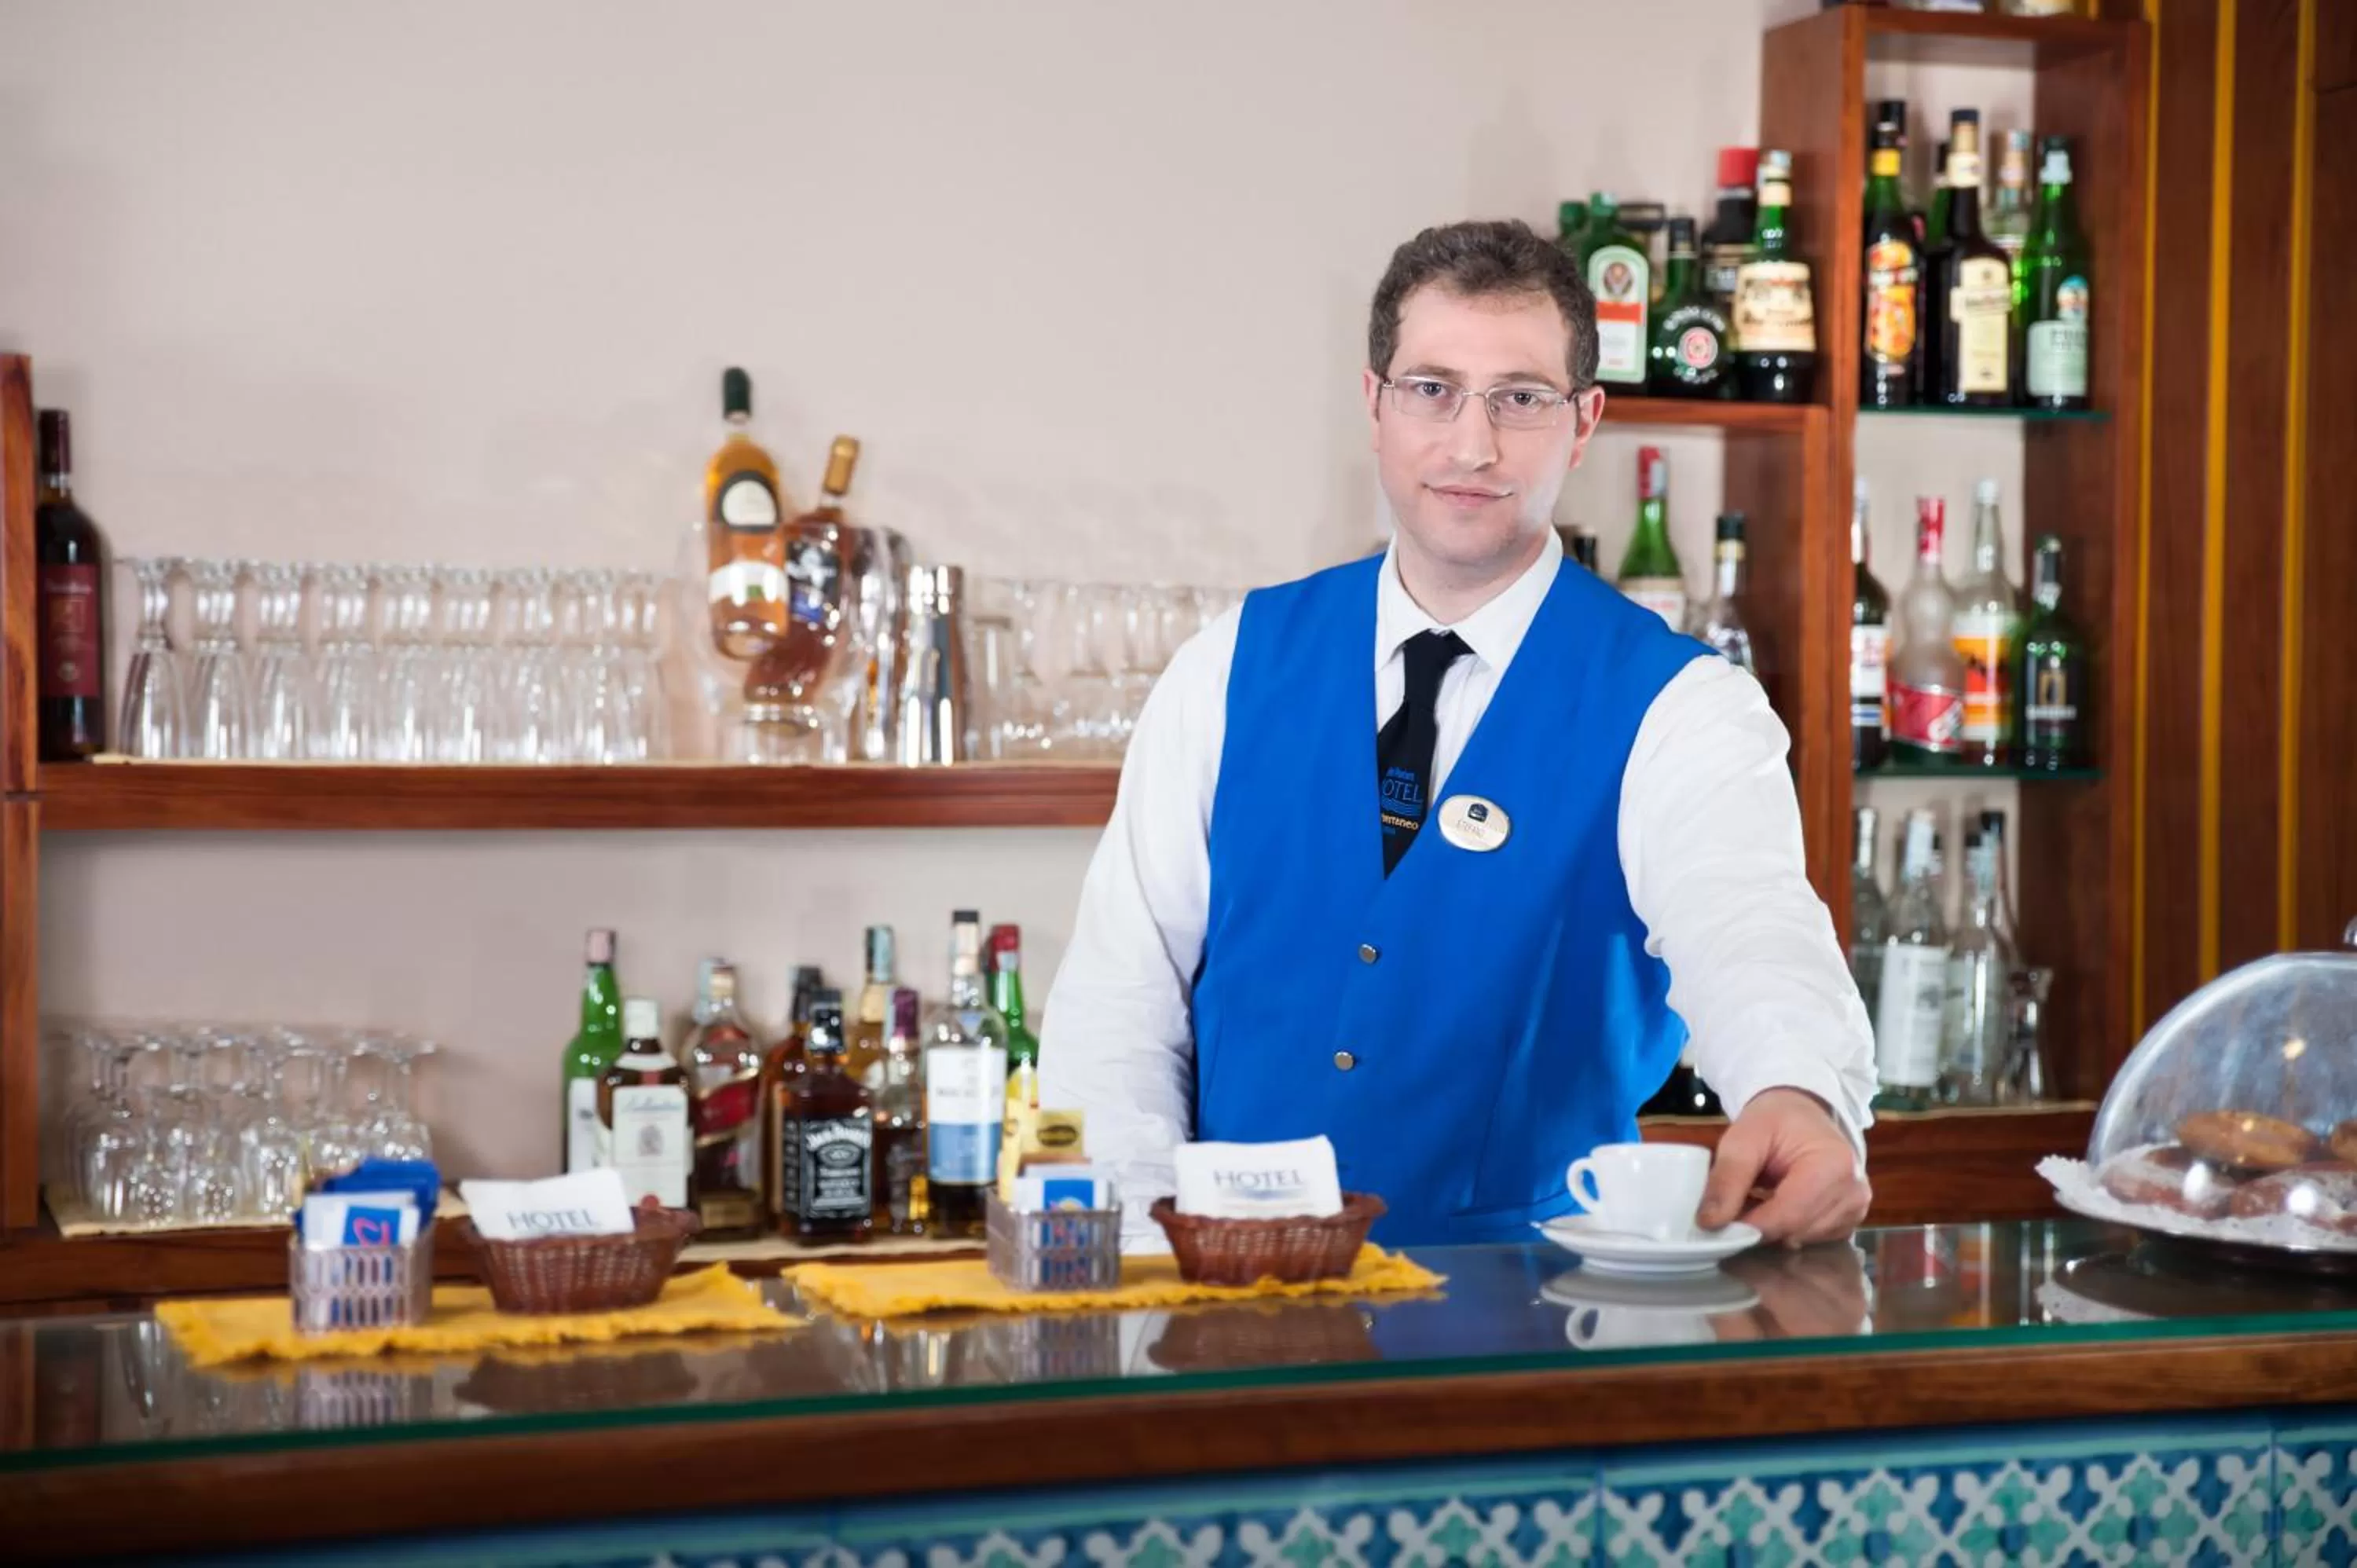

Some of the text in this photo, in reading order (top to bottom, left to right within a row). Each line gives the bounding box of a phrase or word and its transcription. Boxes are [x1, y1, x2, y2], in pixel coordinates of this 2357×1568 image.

[1382, 778, 1424, 802] OTEL
[1213, 1168, 1303, 1188] HOTEL
[505, 1208, 603, 1231] HOTEL
